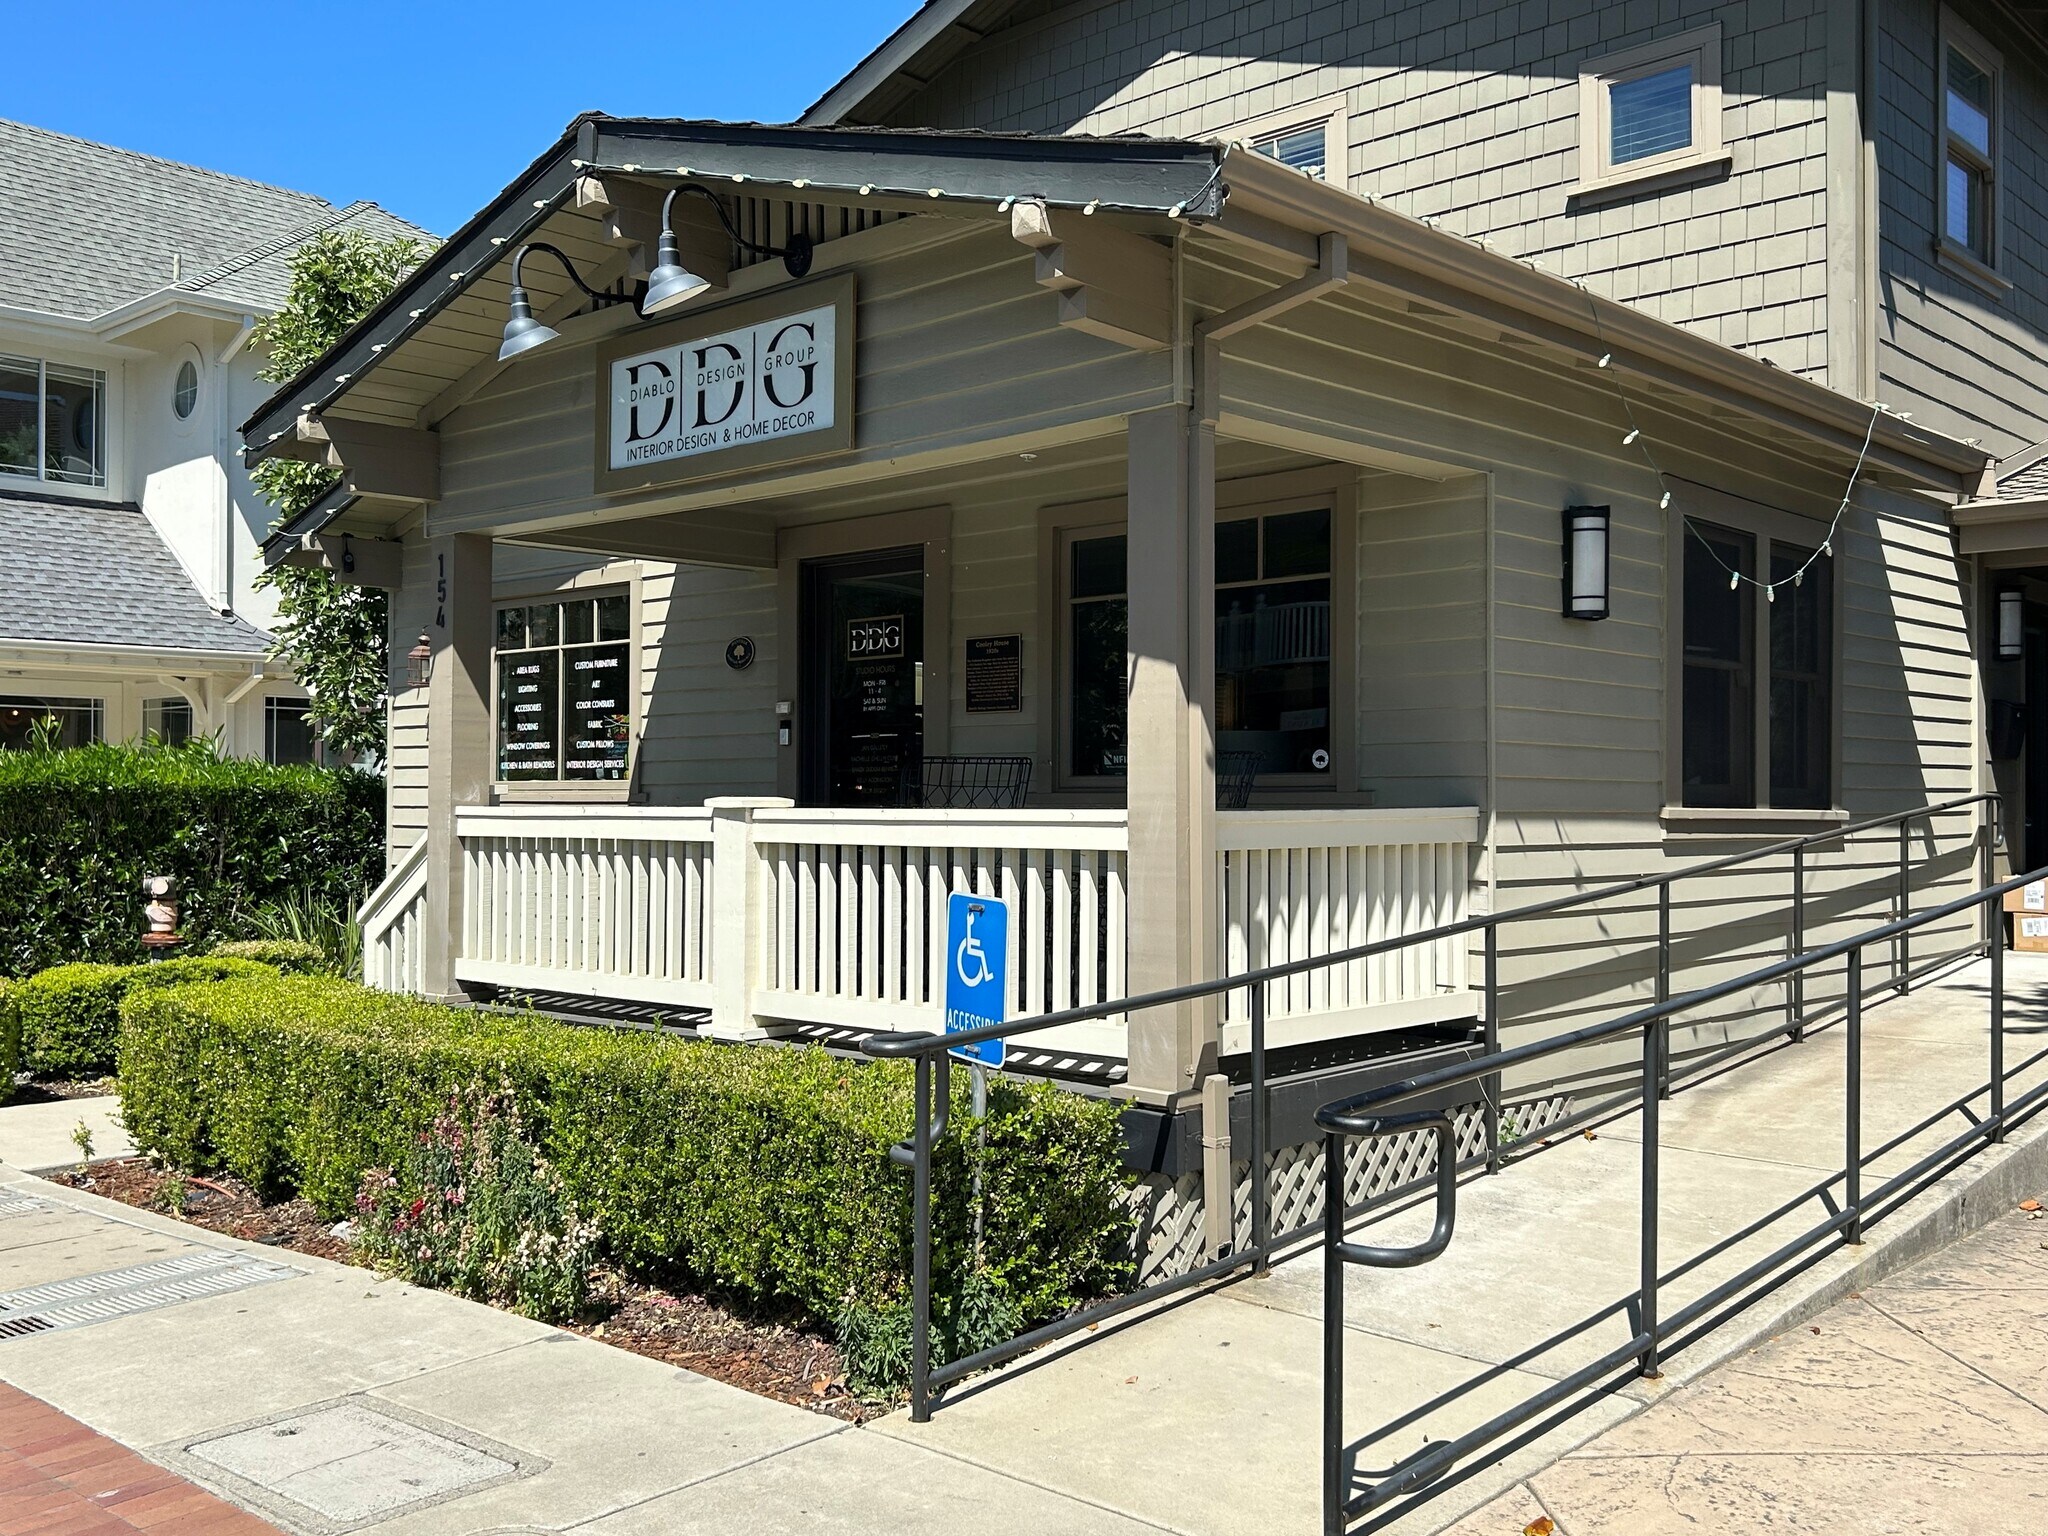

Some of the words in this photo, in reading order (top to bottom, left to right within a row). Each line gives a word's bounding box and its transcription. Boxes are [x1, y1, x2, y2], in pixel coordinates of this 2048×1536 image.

[630, 380, 675, 402] DIABLO
[697, 363, 745, 386] DESIGN
[764, 346, 814, 371] GROUP
[626, 440, 674, 462] INTERIOR
[676, 431, 717, 452] DESIGN
[723, 428, 731, 442] &
[734, 420, 769, 440] HOME
[772, 410, 815, 433] DECOR
[435, 553, 447, 629] 154
[574, 661, 594, 670] CUSTOM
[516, 666, 528, 675] AREA
[863, 680, 876, 688] MON
[517, 684, 538, 694] LIGHTING
[876, 696, 887, 704] SUN
[513, 703, 542, 713] ACCESSORIES
[576, 701, 591, 710] COLOR
[516, 722, 539, 731] FLOORING
[587, 720, 603, 729] FABRIC
[506, 742, 526, 751] WINDOW
[576, 740, 595, 749] CUSTOM
[595, 739, 615, 748] PILLOWS
[566, 760, 586, 769] INTERIOR
[586, 759, 603, 769] DESIGN
[603, 758, 624, 769] SERVICES
